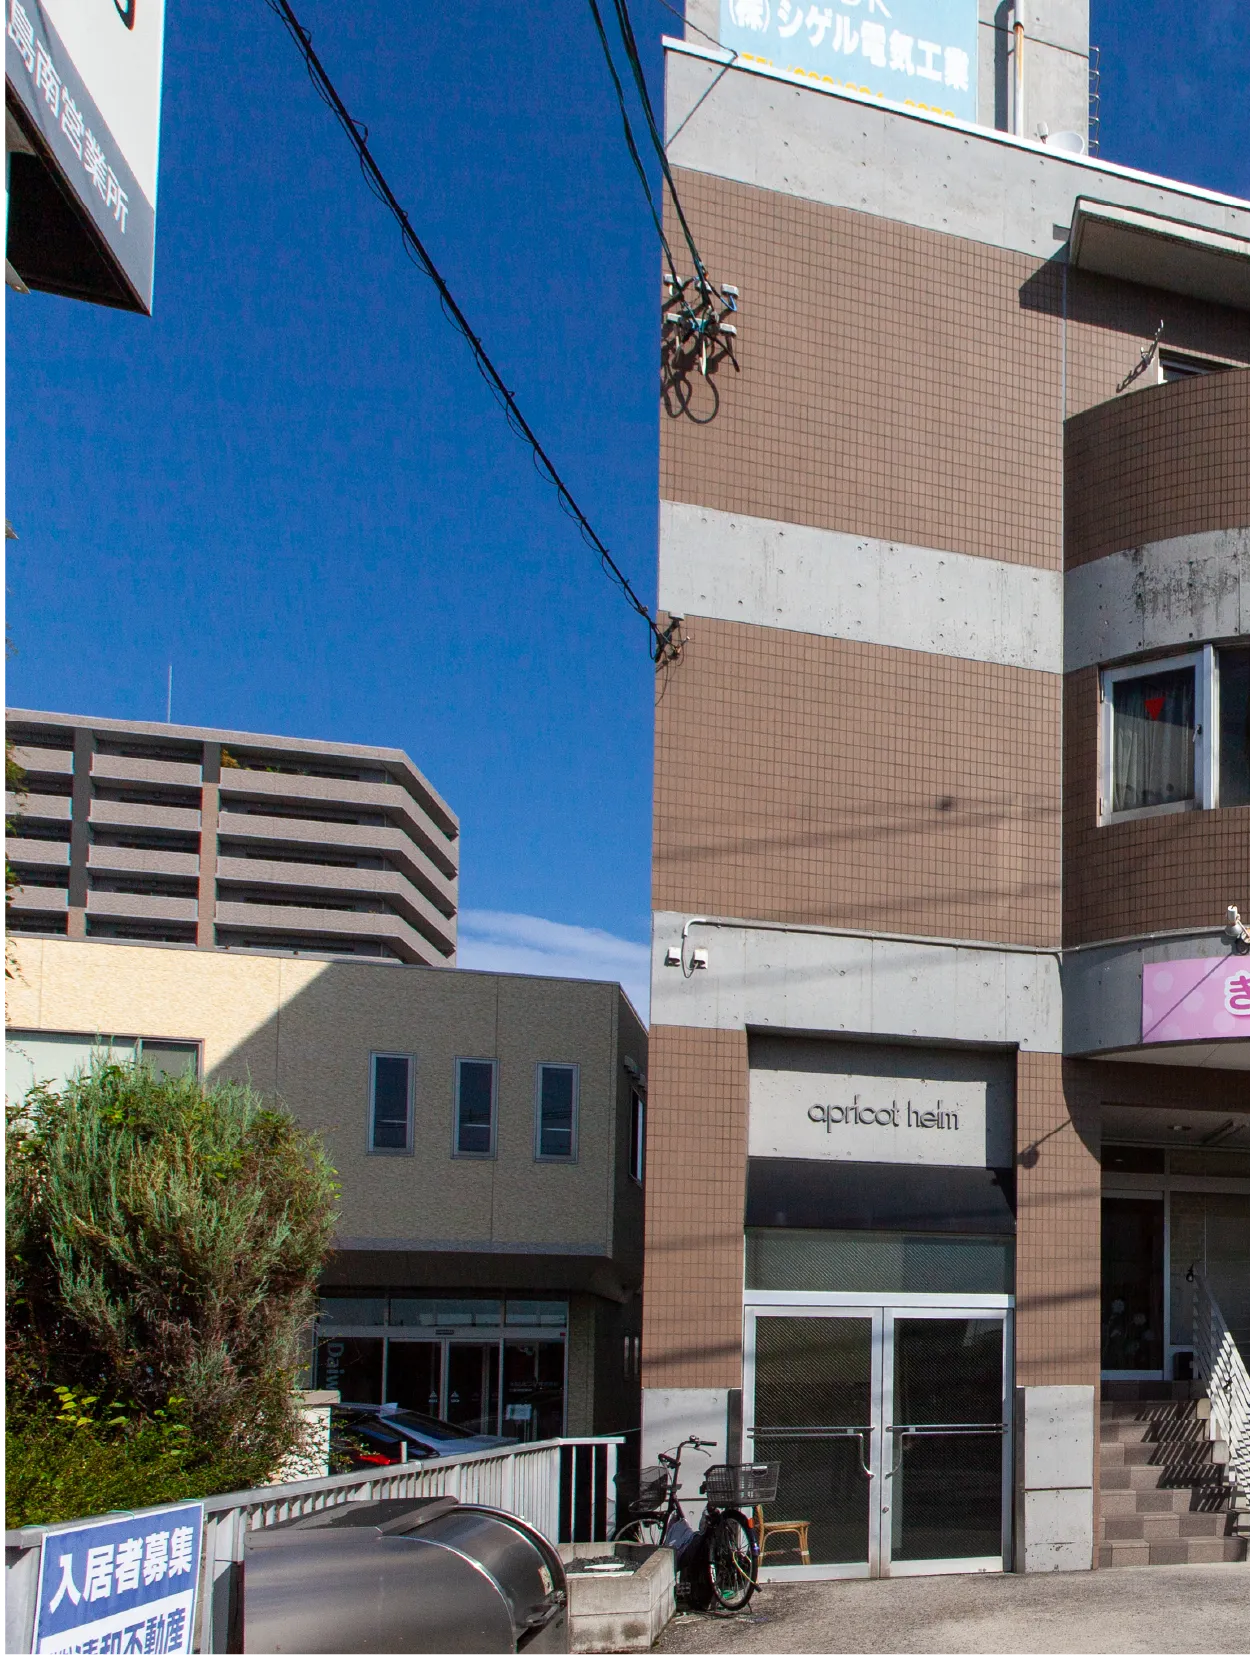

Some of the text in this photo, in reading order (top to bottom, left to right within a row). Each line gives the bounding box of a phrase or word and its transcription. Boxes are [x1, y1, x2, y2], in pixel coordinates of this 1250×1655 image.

[808, 1094, 959, 1133] apricot heim
[49, 1526, 195, 1614] 入居者募集
